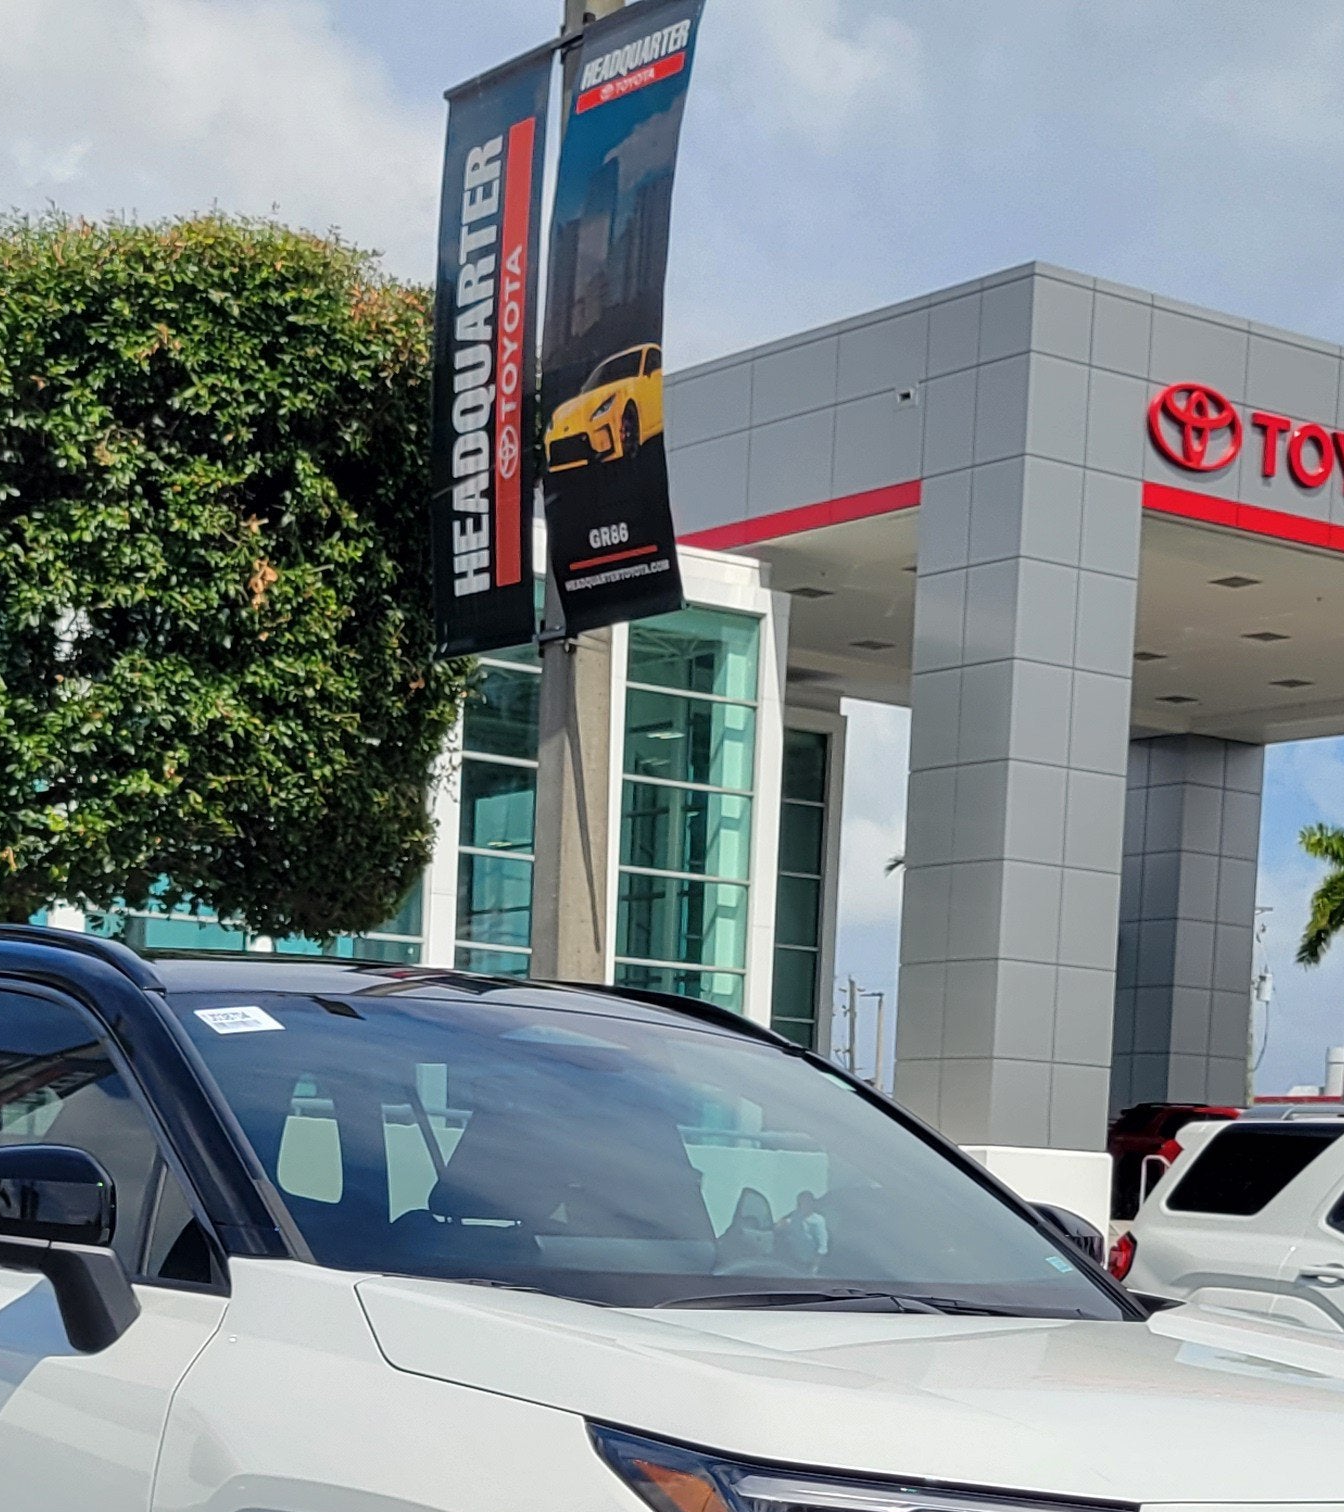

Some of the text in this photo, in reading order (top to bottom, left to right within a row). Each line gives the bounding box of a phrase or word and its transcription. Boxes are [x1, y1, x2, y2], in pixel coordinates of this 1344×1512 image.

[579, 18, 692, 92] HEADQUARTER
[451, 134, 503, 597] HEADQUARTER
[500, 244, 523, 422] TOYOTA
[589, 521, 629, 549] GR86
